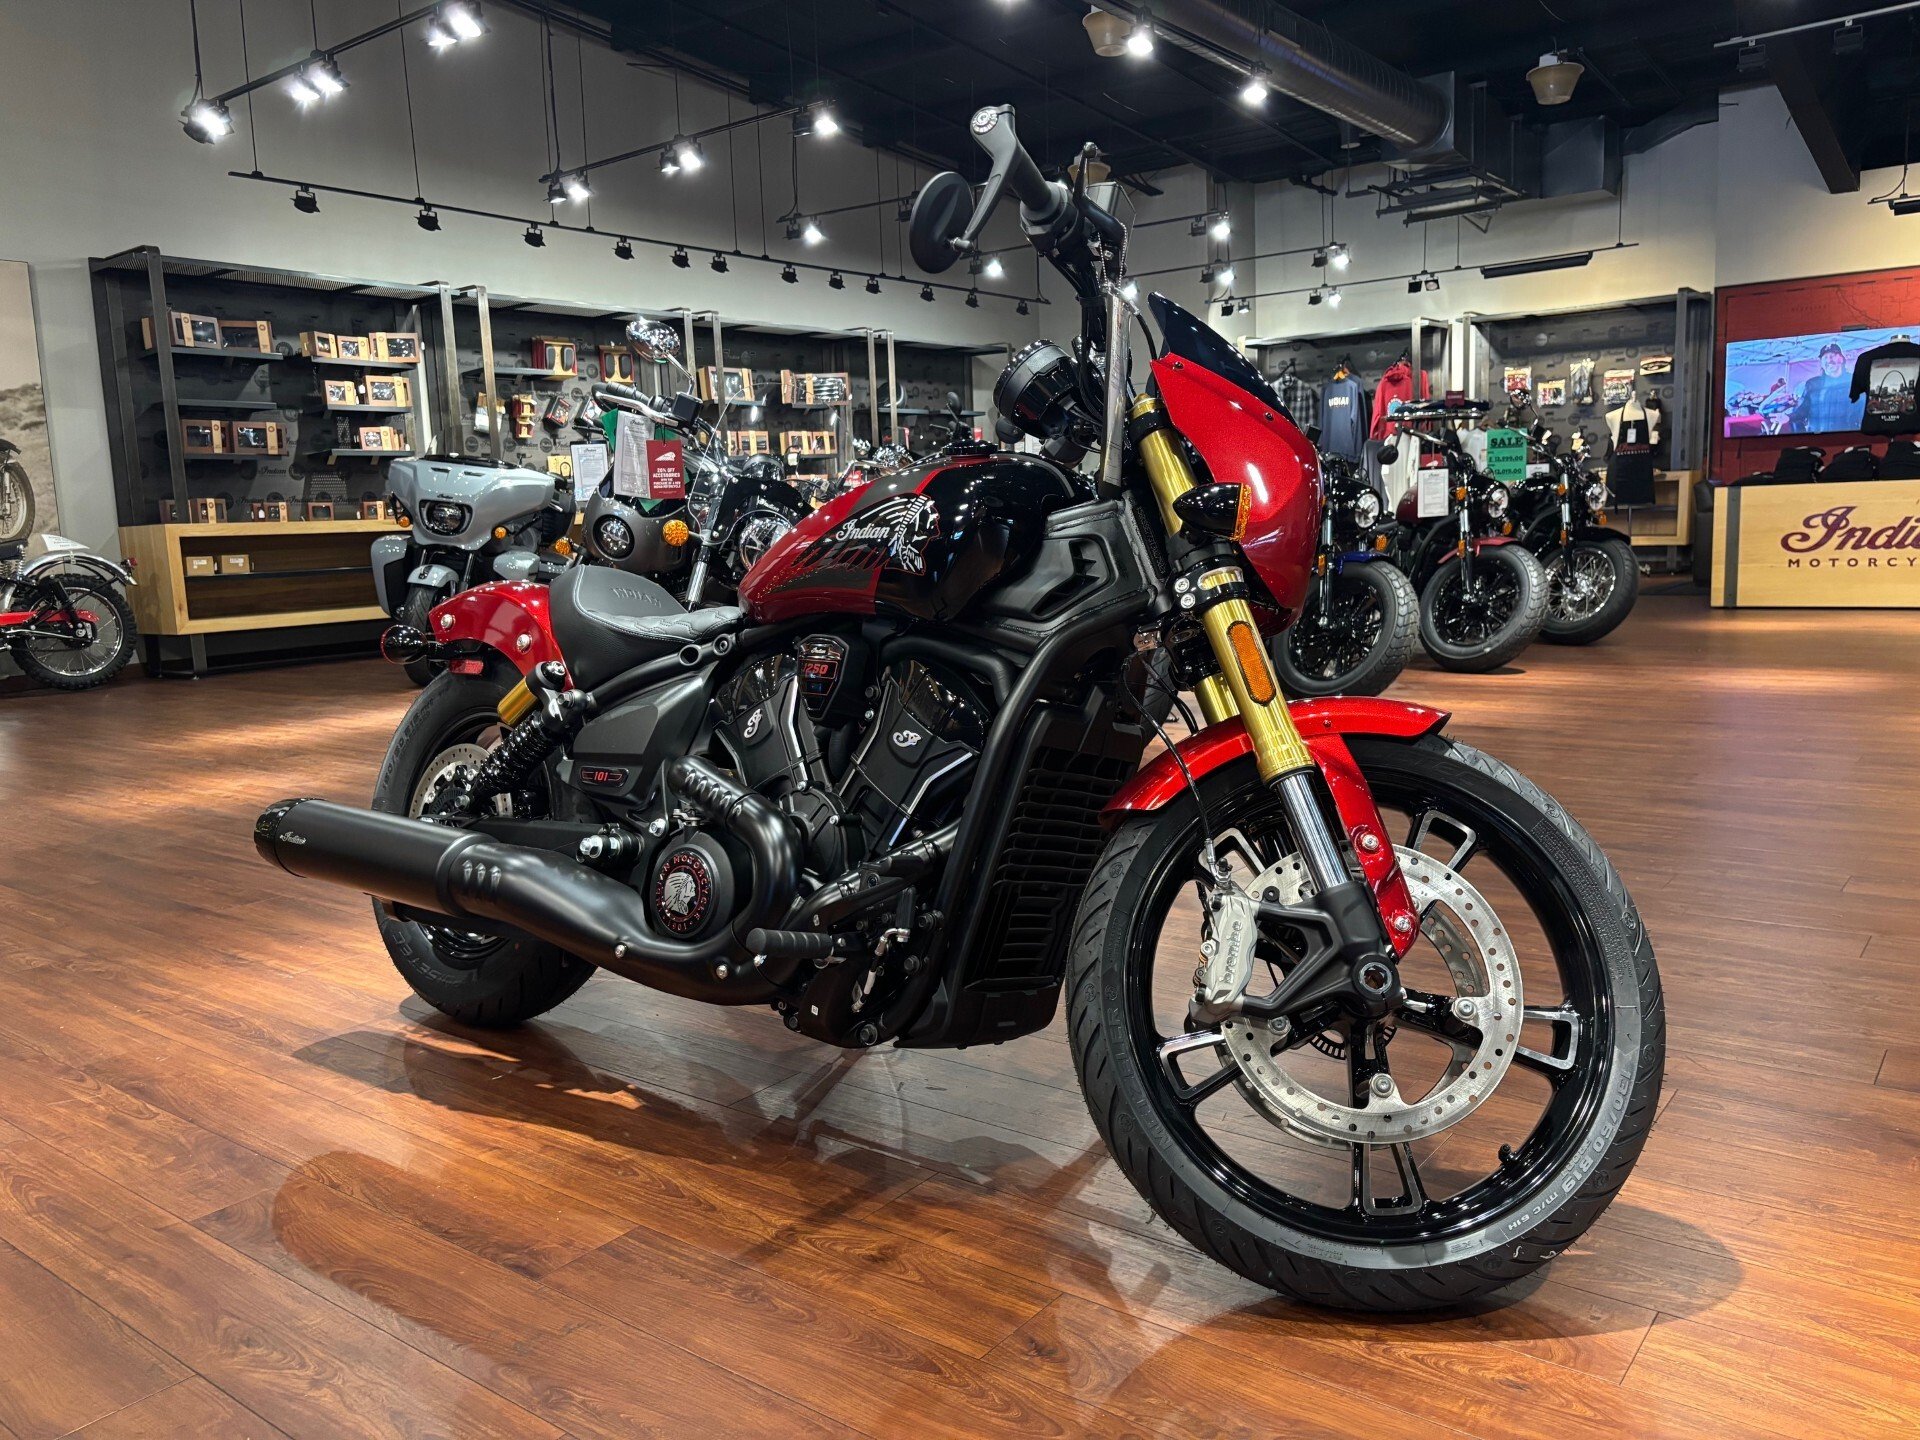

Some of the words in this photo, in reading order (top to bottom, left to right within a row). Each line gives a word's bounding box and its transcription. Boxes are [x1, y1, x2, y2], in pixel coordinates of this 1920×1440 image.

[1490, 436, 1524, 448] SALE
[835, 519, 891, 541] Indian
[1780, 505, 1920, 553] Indi
[1788, 557, 1918, 568] MOTORCY
[594, 771, 609, 782] 101
[279, 831, 308, 846] Indian
[1220, 920, 1243, 984] brembo
[1107, 1006, 1174, 1151] METZELER
[1560, 1154, 1595, 1195] B19
